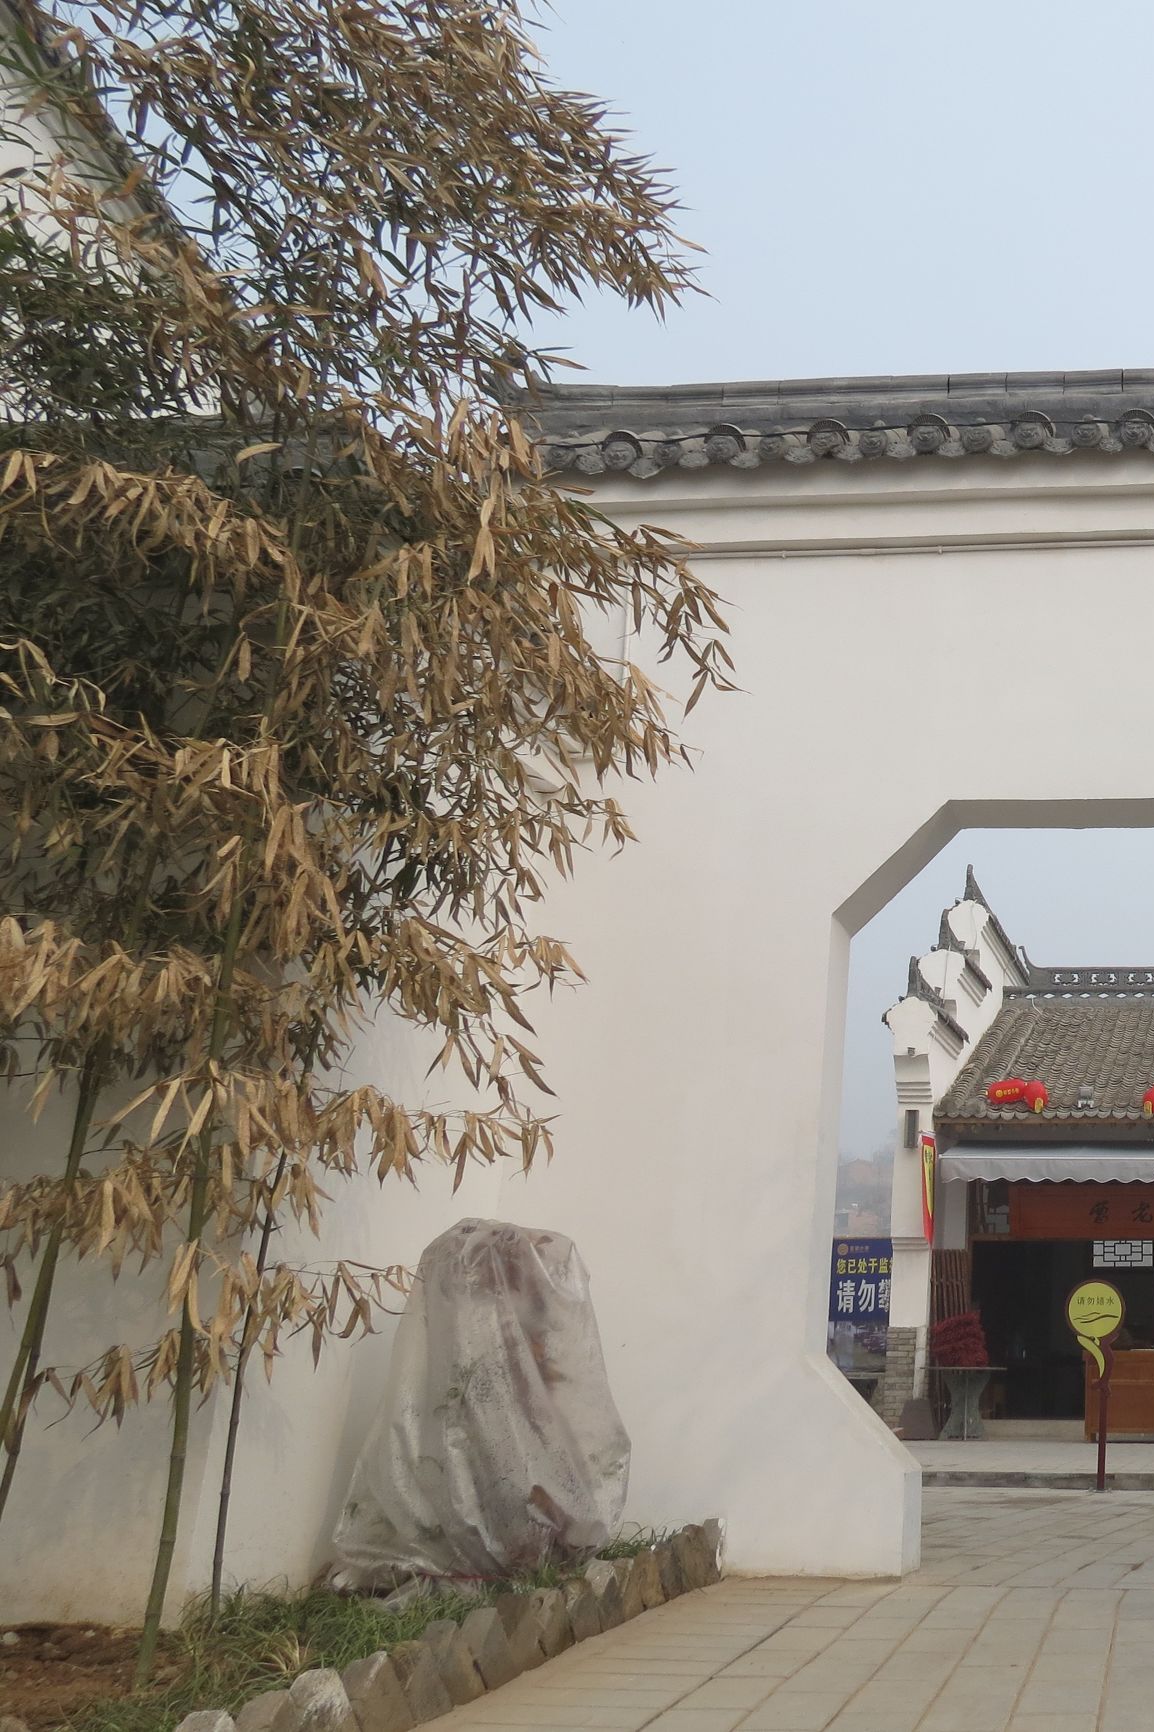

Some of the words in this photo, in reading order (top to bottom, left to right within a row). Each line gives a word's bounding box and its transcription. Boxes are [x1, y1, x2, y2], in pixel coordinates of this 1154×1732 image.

[836, 1257, 893, 1274] 您已处于监
